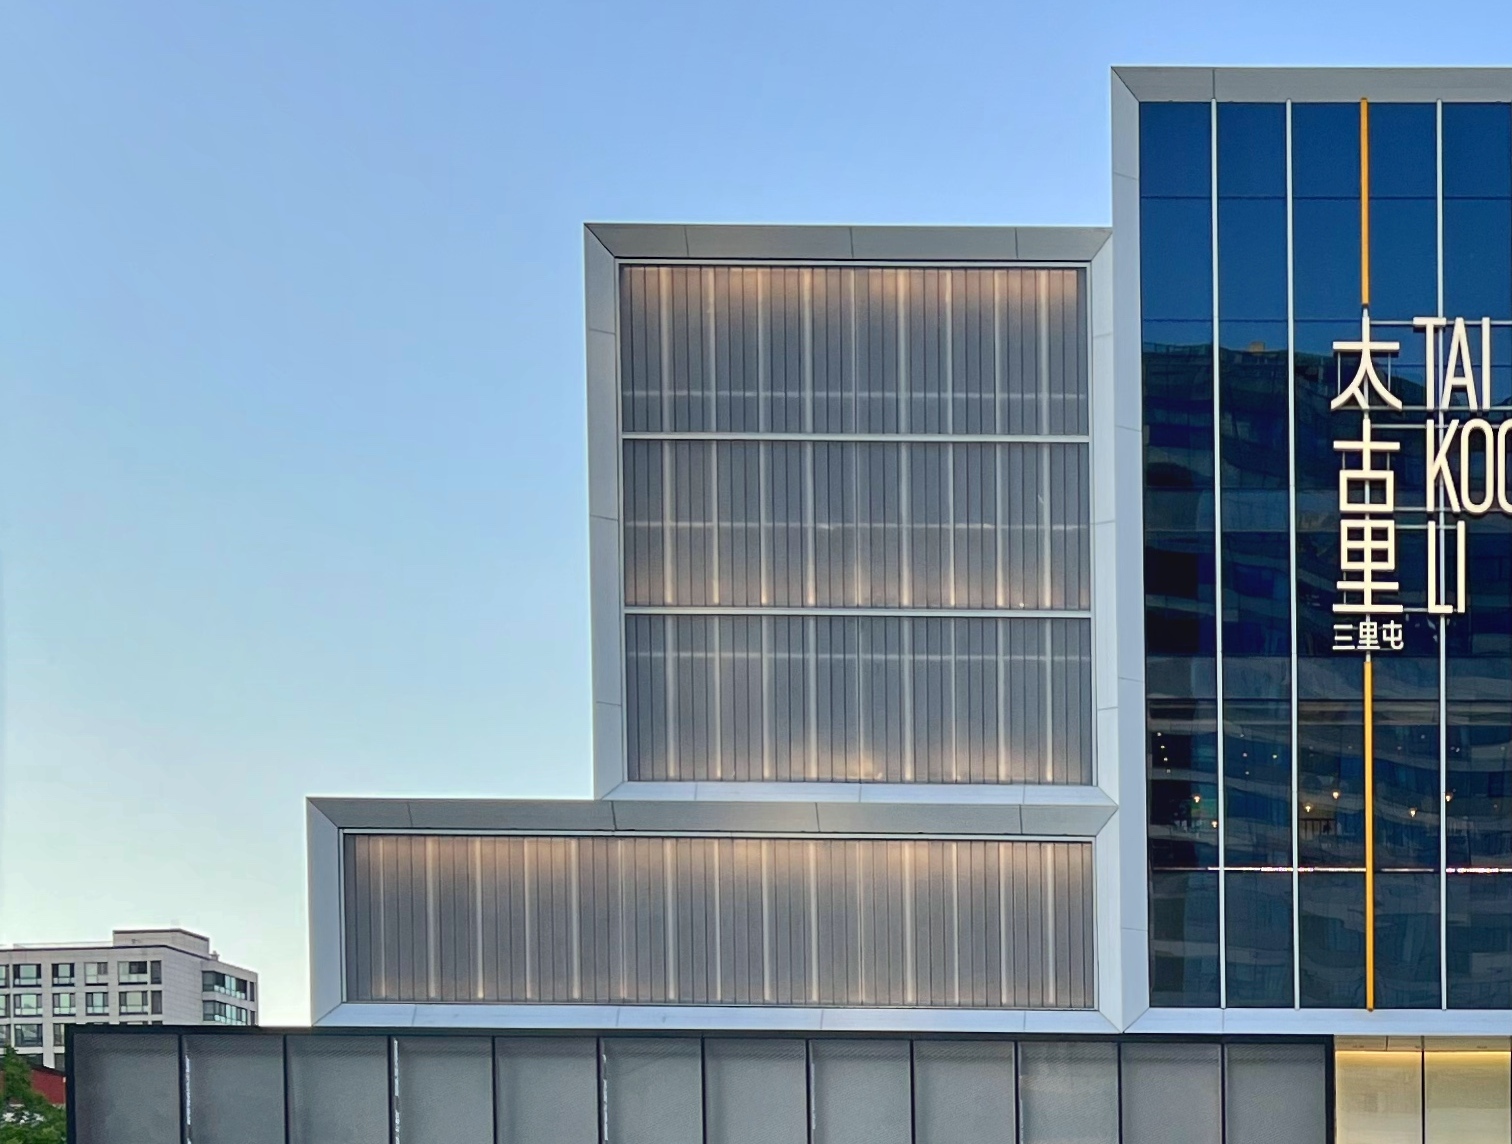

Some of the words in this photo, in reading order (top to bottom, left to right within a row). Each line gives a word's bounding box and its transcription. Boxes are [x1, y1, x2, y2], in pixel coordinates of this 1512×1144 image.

[1412, 316, 1491, 411] TAI
[1330, 309, 1404, 613] 太古里
[1427, 520, 1466, 614] LI
[1332, 620, 1404, 650] 三里屯
